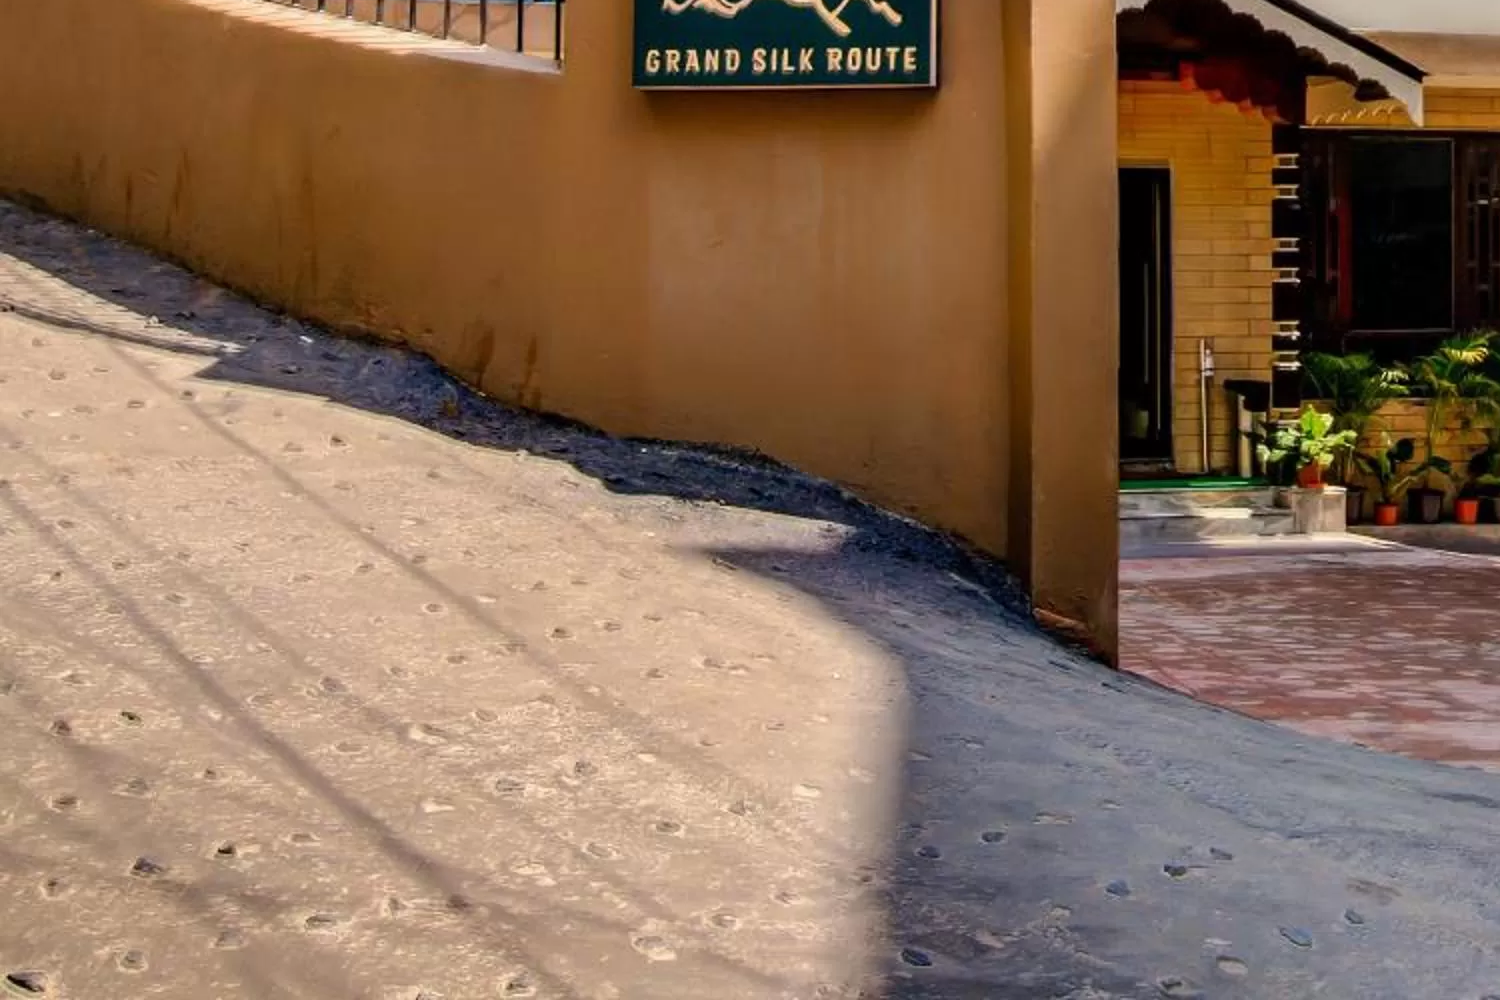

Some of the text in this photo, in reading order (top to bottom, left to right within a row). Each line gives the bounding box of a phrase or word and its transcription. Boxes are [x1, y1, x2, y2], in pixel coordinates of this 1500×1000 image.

[645, 46, 917, 74] GRAND SILK ROUTE
